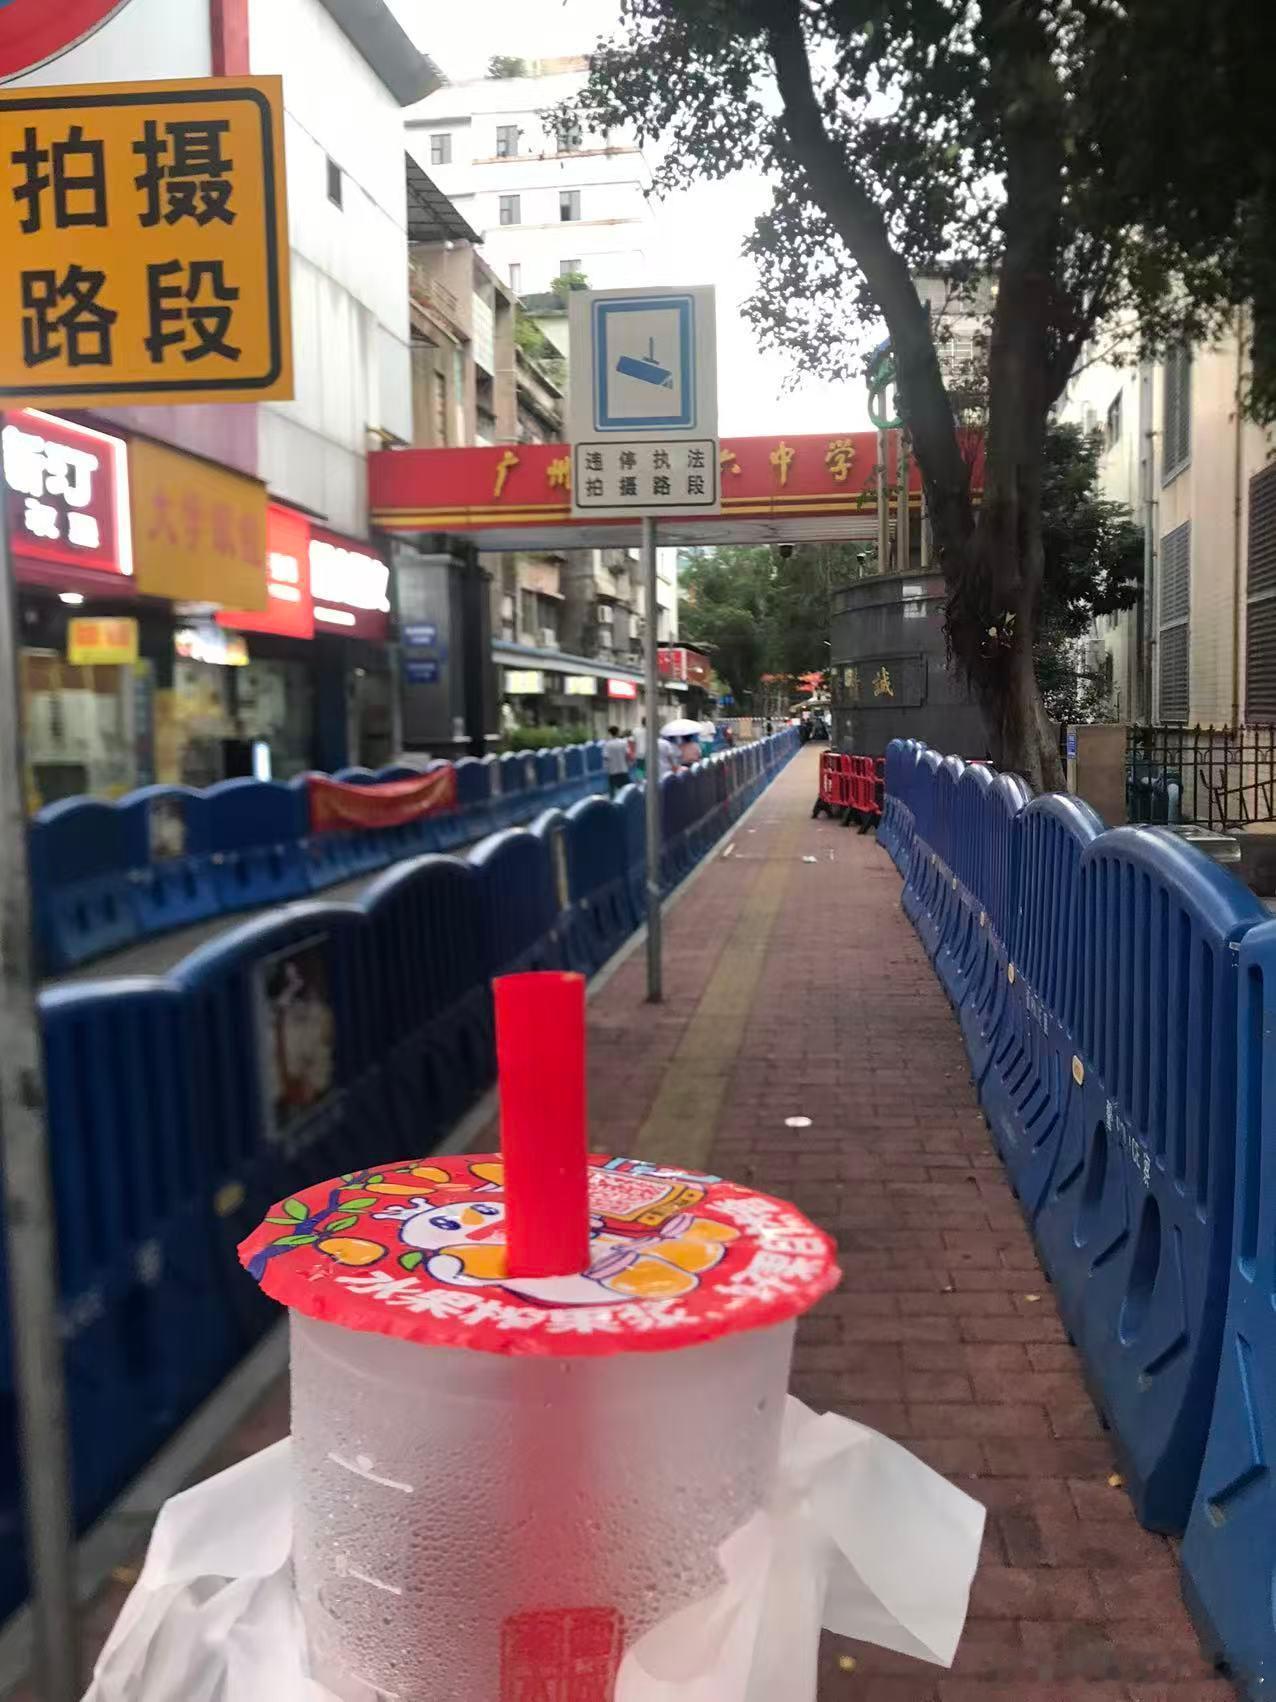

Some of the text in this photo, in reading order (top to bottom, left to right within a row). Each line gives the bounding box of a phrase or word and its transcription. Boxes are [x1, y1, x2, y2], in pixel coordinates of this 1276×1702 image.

[11, 119, 237, 234] 拍摄
[21, 258, 242, 367] 路段
[585, 449, 705, 473] 违停执法
[585, 475, 705, 497] 拍摄路段
